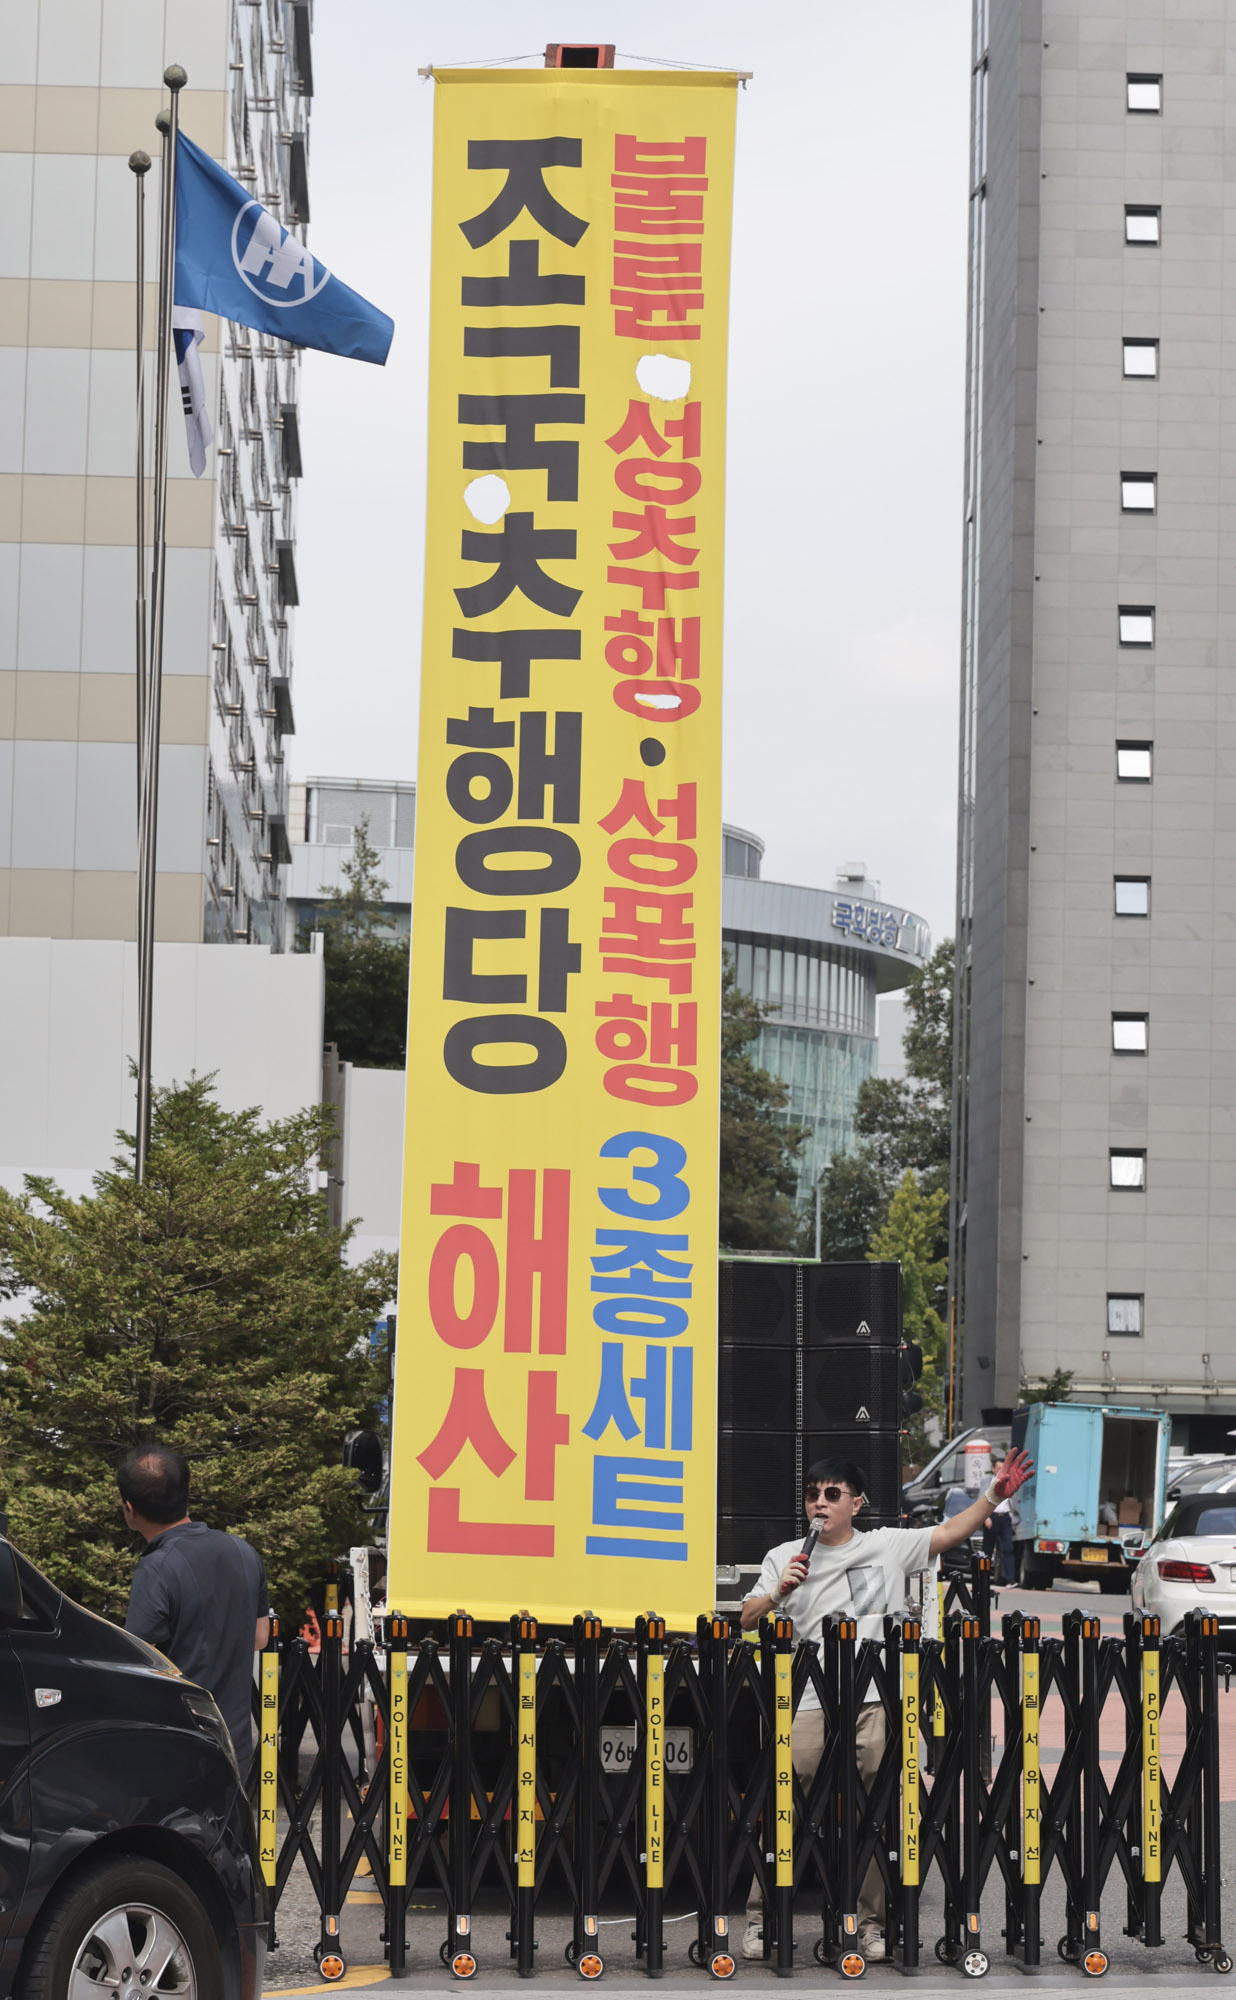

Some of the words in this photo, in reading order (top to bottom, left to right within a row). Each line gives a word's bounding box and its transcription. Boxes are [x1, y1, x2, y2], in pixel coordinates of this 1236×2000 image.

[443, 136, 590, 1095] 조국추행당
[832, 901, 898, 948] 국회방송
[415, 1160, 571, 1558] 해산
[393, 1694, 404, 1784] POLICE
[650, 1697, 662, 1786] POLICE
[905, 1695, 917, 1785] POLICE
[1146, 1692, 1158, 1782] POLICE
[393, 1801, 404, 1861] LINE
[650, 1804, 662, 1863] LINE
[905, 1802, 917, 1861] LINE
[1146, 1799, 1158, 1857] LINE
